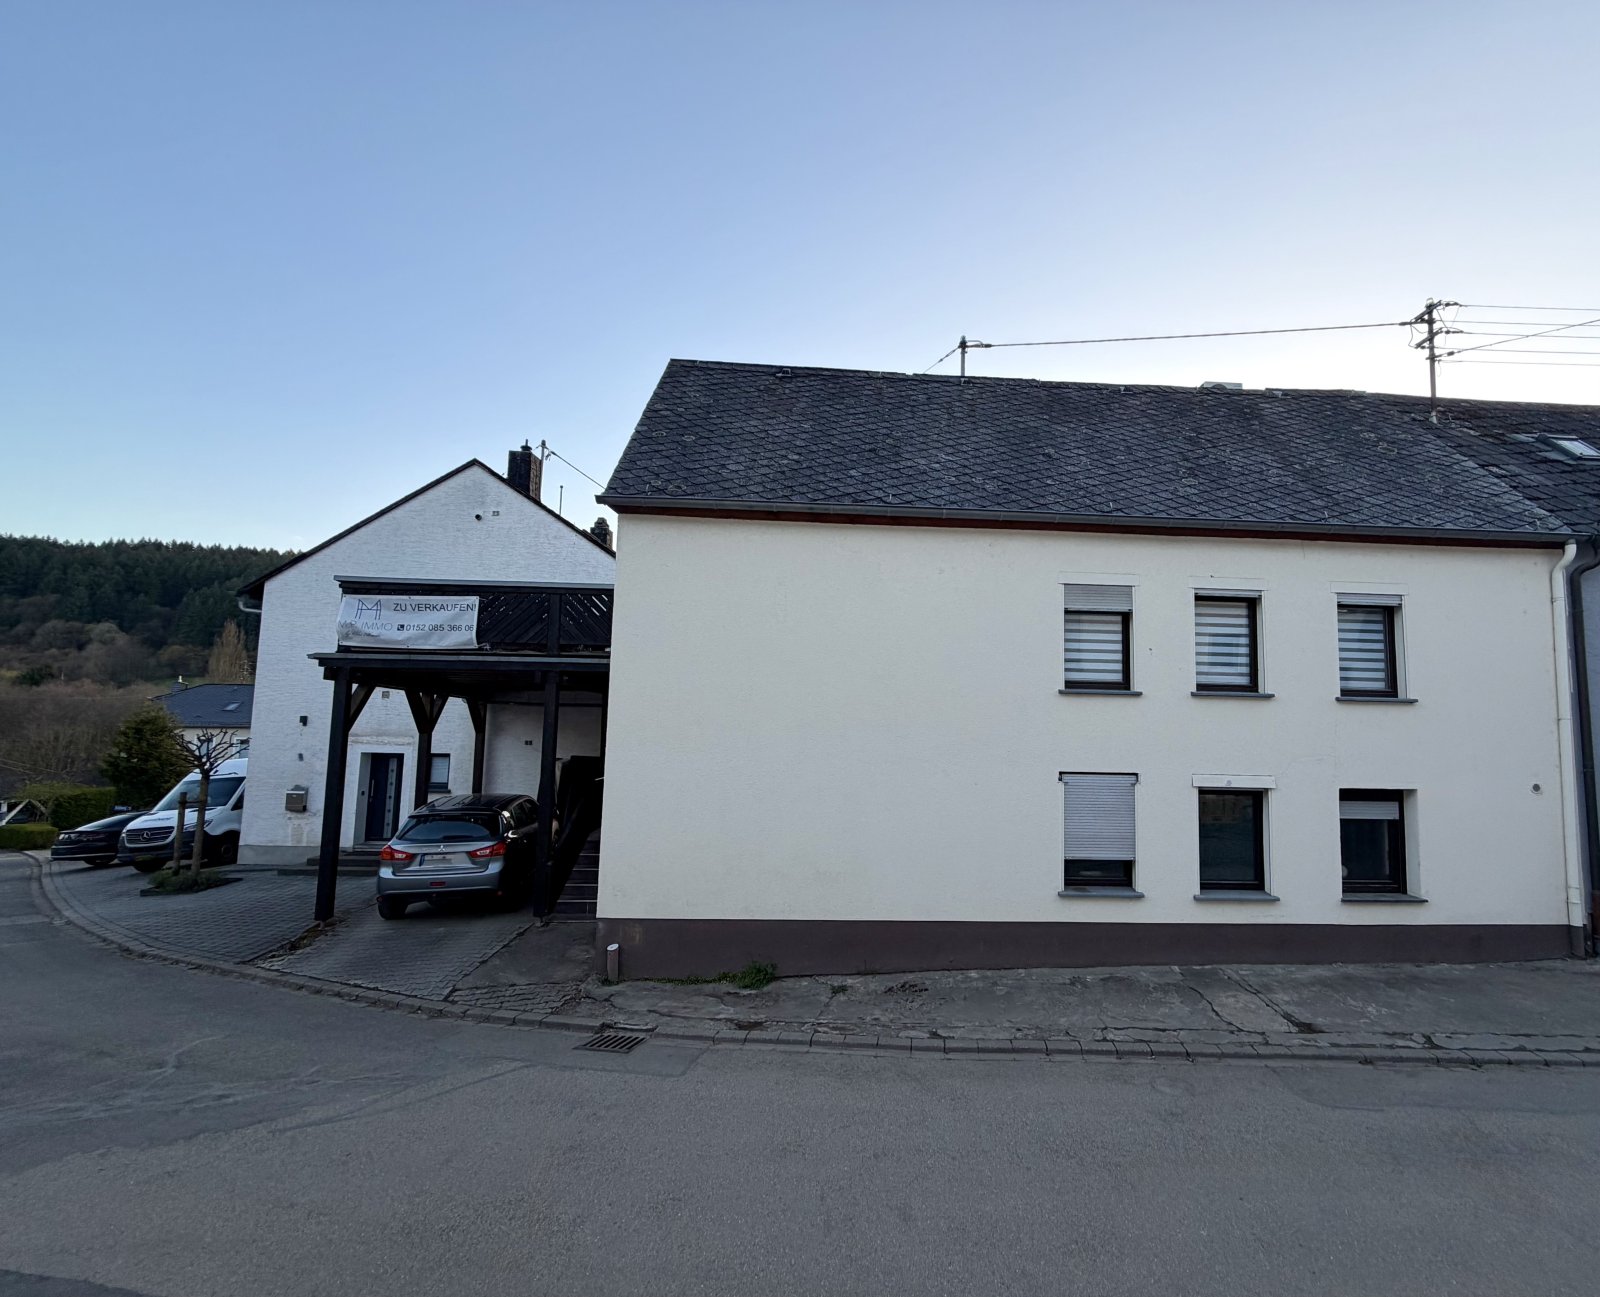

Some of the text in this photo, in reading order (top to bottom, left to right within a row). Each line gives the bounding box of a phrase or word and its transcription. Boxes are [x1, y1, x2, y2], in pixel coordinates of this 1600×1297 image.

[393, 602, 477, 612] ZU VERKAUFEN!
[361, 621, 393, 631] IMMO
[405, 623, 426, 632] 0152
